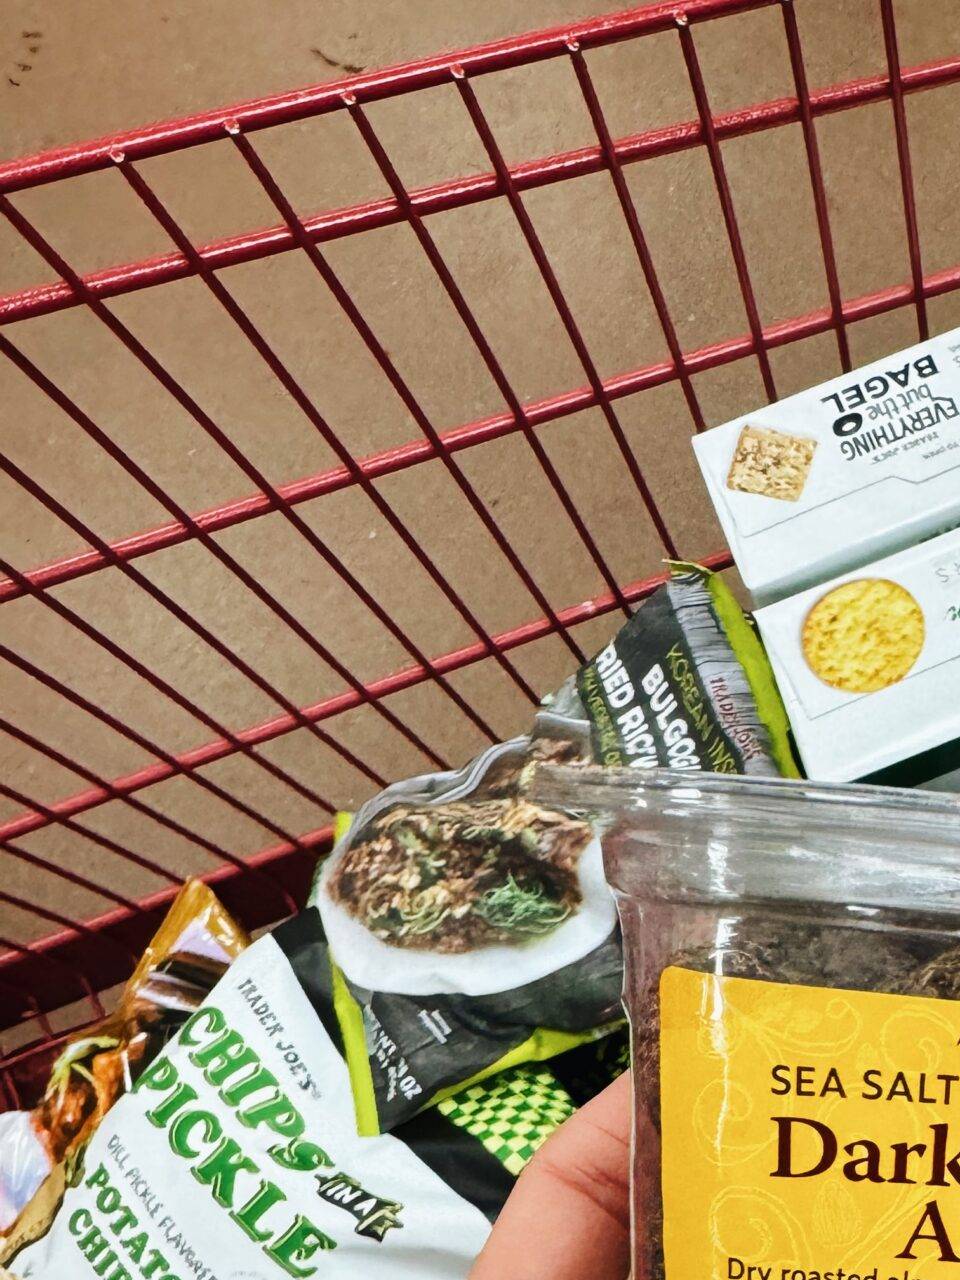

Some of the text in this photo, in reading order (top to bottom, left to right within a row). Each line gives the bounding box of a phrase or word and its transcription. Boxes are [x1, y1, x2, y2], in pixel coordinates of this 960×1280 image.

[821, 355, 939, 412] BAGEL
[865, 383, 933, 421] but the
[840, 397, 960, 461] EVERYTHING
[596, 643, 636, 709] RIED
[237, 979, 285, 1037] TRADER
[178, 1007, 336, 1172] CHIPS
[771, 1064, 847, 1099] SEA
[861, 1069, 960, 1106] SALT
[106, 1133, 128, 1172] DILL
[125, 1167, 165, 1220] PICKLE
[131, 1055, 338, 1280] PICKLE
[325, 1177, 355, 1206] IN
